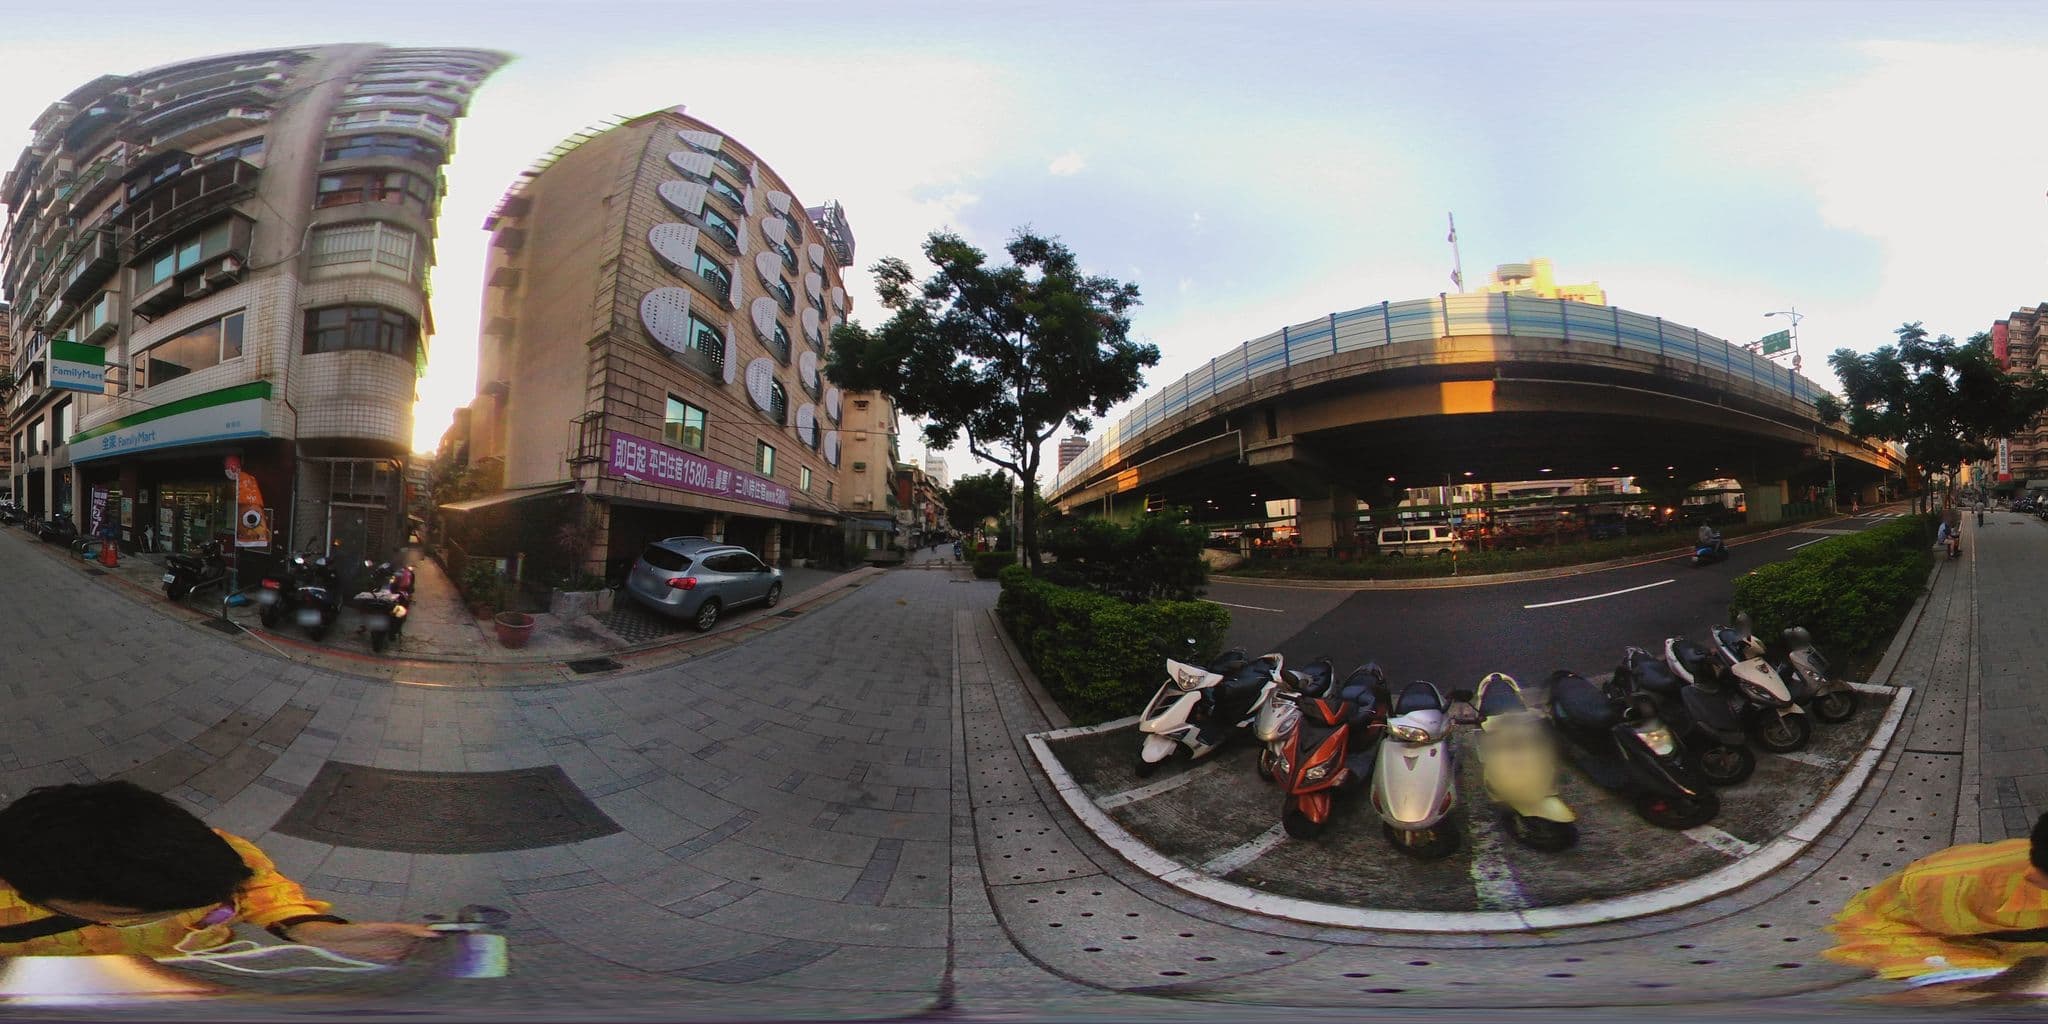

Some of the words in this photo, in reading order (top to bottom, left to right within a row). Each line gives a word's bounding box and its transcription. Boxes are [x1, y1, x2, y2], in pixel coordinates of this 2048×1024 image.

[52, 365, 103, 380] FamilyMart
[614, 438, 647, 473] 即日起
